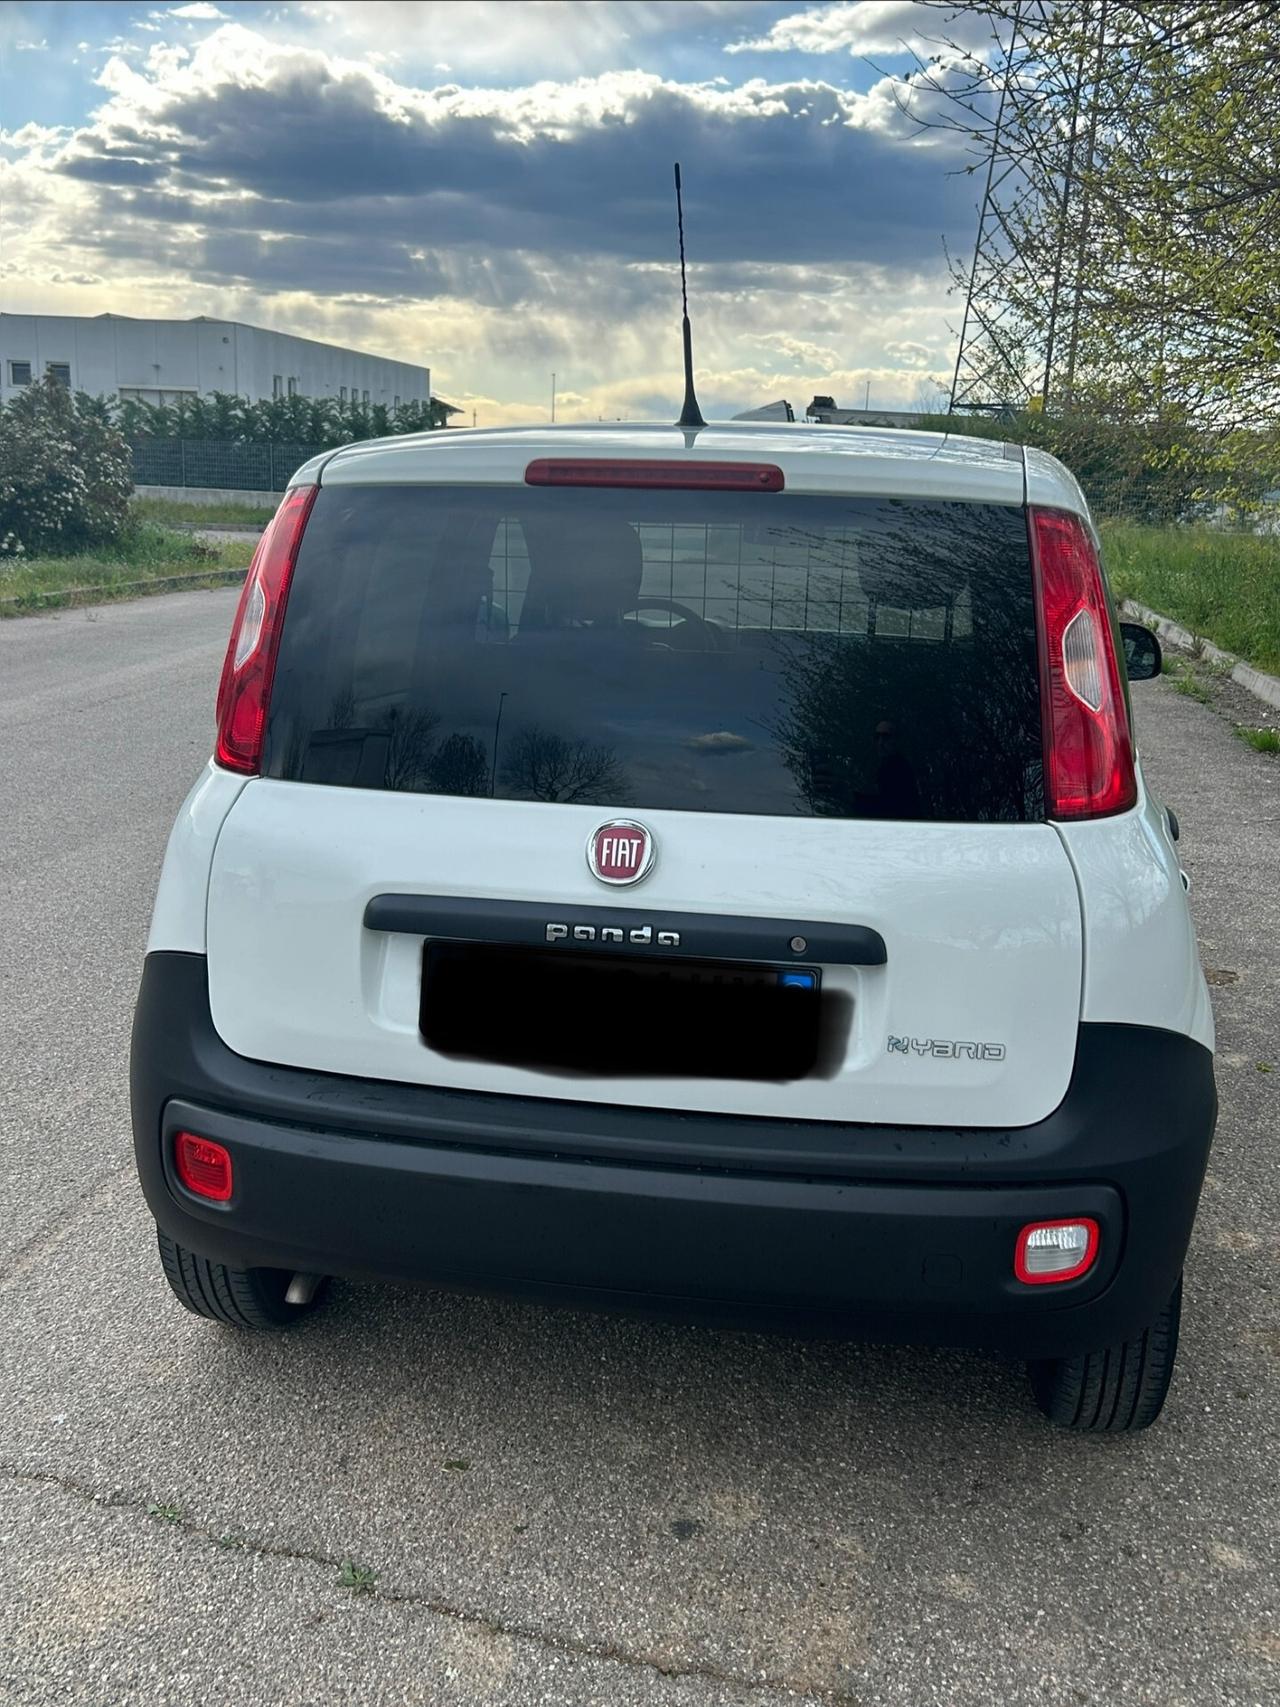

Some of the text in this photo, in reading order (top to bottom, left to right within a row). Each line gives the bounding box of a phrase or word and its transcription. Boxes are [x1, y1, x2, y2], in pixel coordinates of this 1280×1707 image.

[601, 838, 641, 868] FIAT
[546, 923, 680, 946] panda
[887, 1035, 1006, 1061] HYBRID
